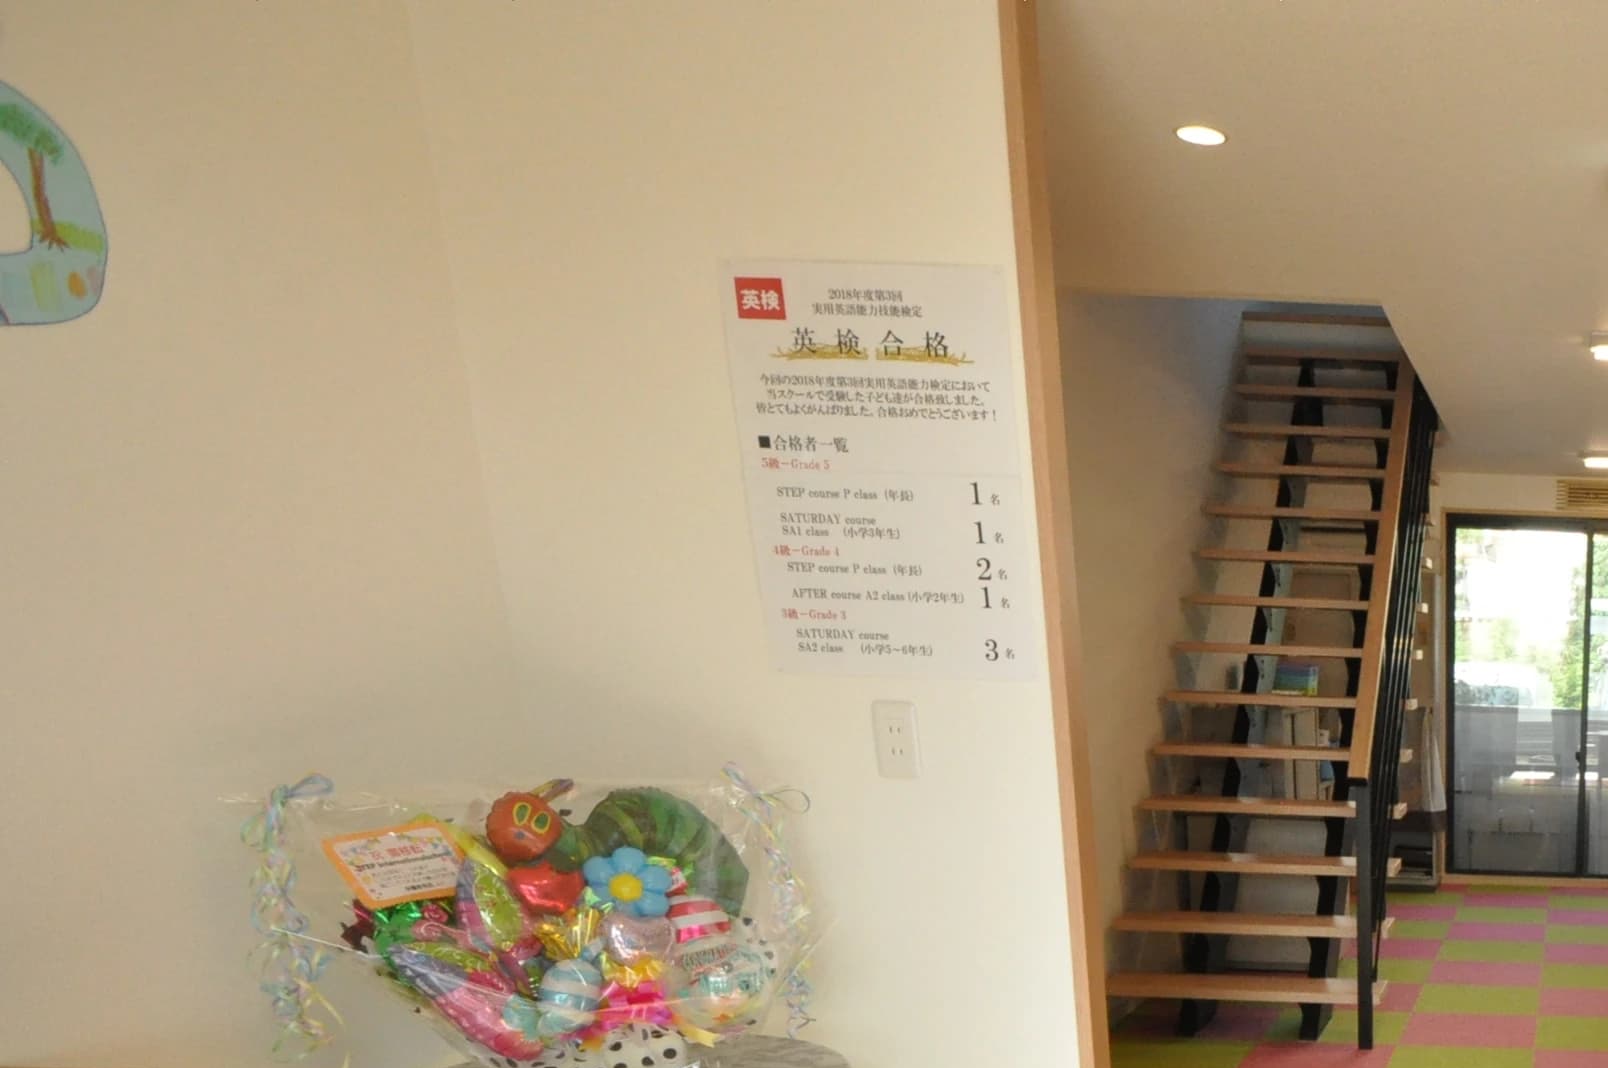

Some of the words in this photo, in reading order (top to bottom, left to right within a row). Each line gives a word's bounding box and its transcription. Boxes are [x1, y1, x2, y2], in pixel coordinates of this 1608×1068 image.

[739, 288, 781, 311] 英検
[776, 486, 805, 498] STEP
[808, 489, 840, 499] course
[843, 488, 851, 499] P
[854, 488, 878, 500] class
[969, 481, 982, 505] 1
[779, 512, 841, 525] SATURDAY
[844, 517, 877, 526] course
[781, 525, 802, 537] SA1
[805, 526, 830, 537] class
[973, 521, 987, 544] 1
[787, 561, 815, 573] STEP
[818, 565, 850, 574] course
[853, 563, 861, 574] P
[863, 564, 887, 575] class
[976, 557, 993, 581] 2
[791, 588, 828, 600] AFTER
[831, 591, 862, 601] course
[865, 590, 880, 601] A2
[881, 591, 905, 602] class
[980, 586, 994, 609] 1
[796, 627, 855, 640] SATURDAY
[858, 631, 890, 641] course
[797, 641, 819, 653] SA2
[820, 643, 843, 654] class
[984, 638, 1000, 661] 3
